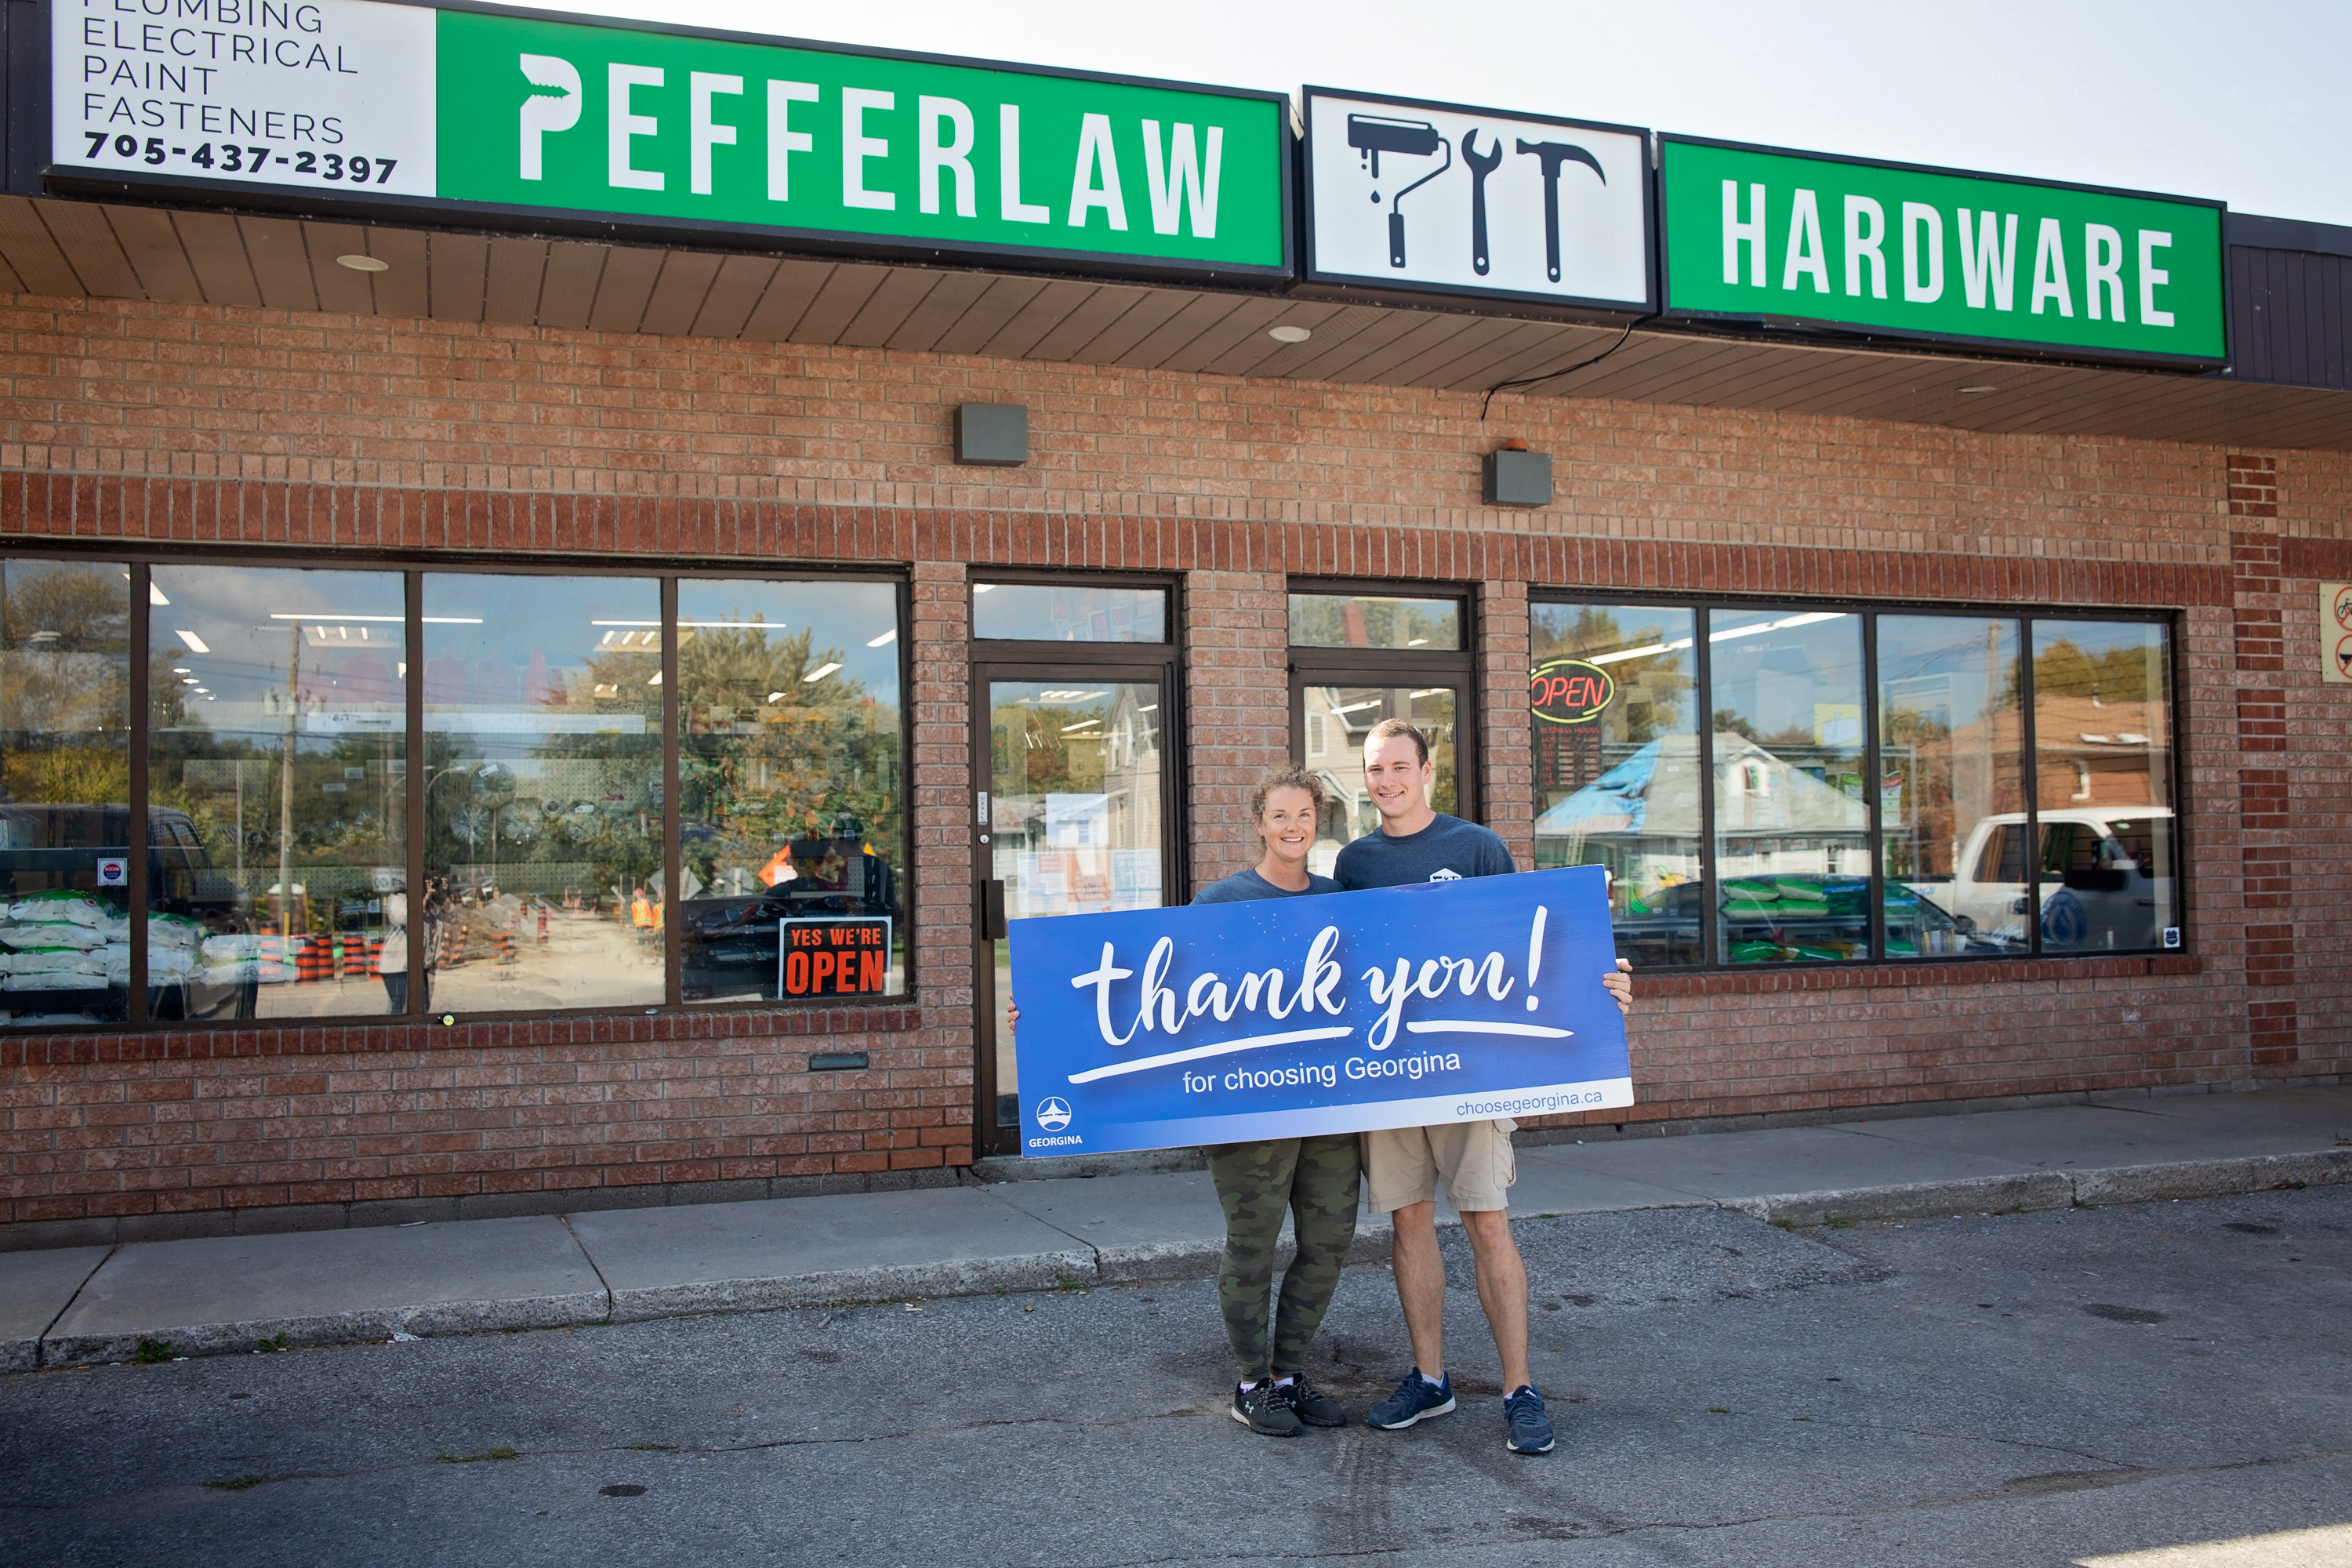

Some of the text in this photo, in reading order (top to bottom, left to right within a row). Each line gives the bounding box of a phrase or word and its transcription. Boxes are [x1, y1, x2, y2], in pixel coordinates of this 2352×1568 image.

[84, 0, 322, 34] UMBING
[84, 16, 358, 74] ELECTRICAL
[84, 54, 218, 96] PAINT
[84, 93, 343, 145] FASTENERS
[84, 131, 398, 185] 705-437-2397
[519, 53, 1225, 240] PEFFERLAW
[1721, 179, 2176, 328] HARDWARE
[1531, 677, 1606, 706] OPEN
[791, 927, 881, 946] YES WE'RE
[786, 950, 884, 994] OPEN
[1071, 905, 1548, 1051] thank you!
[1182, 1051, 1461, 1094] for choosing Georgina
[1456, 1091, 1603, 1116] choosegeorgina.ca
[1029, 1134, 1083, 1148] GEORGINA
